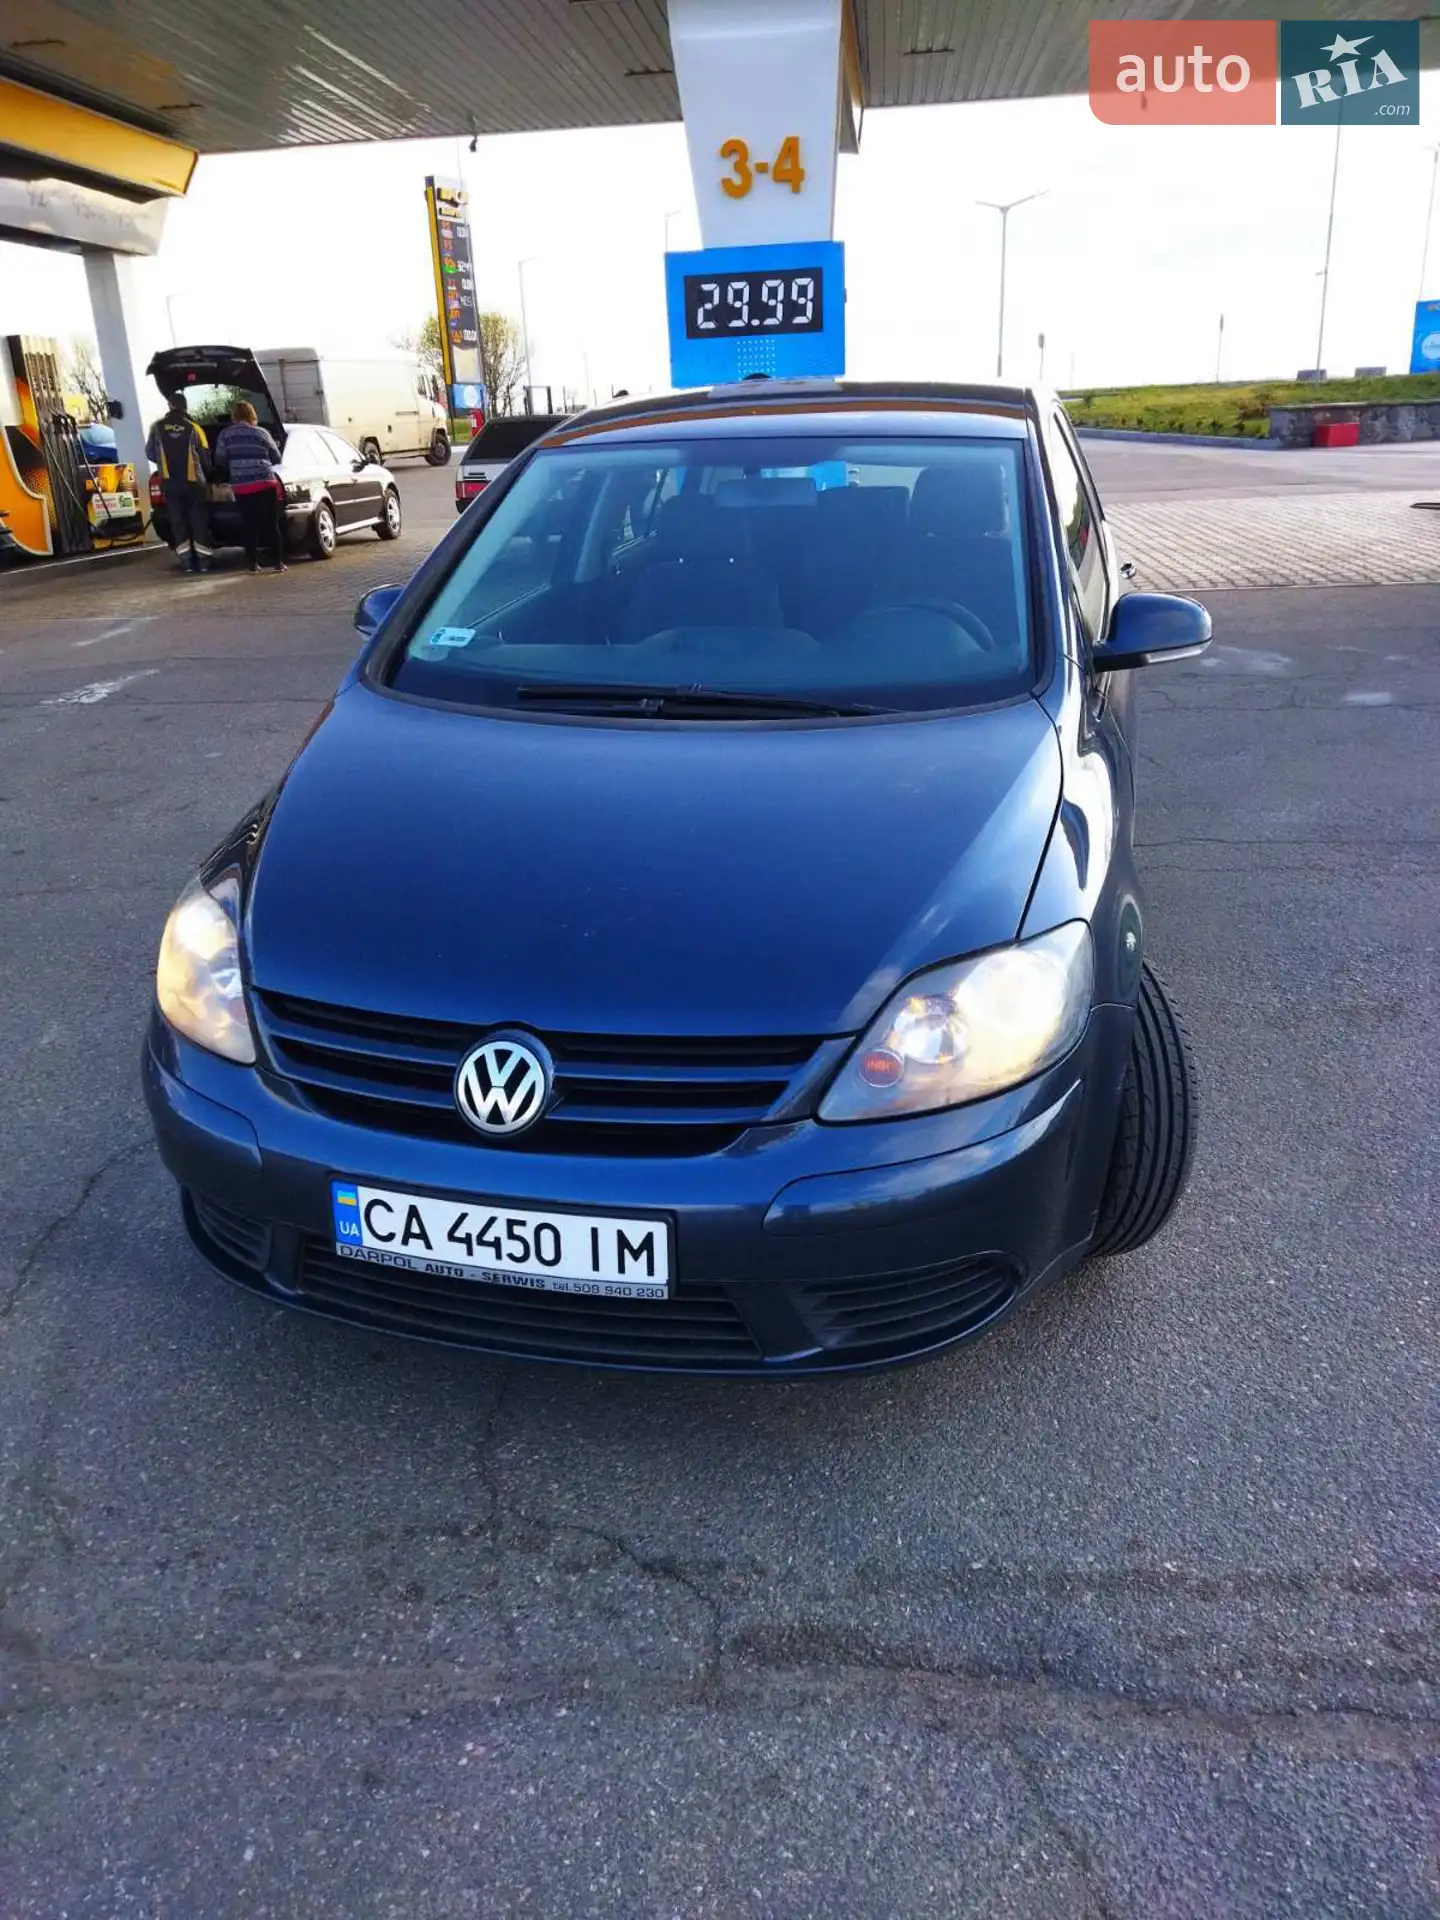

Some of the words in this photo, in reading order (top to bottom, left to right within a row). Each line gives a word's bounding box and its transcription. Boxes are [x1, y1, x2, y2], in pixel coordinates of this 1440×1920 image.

[720, 136, 805, 199] 3-4
[697, 277, 815, 329] 29.99
[339, 1220, 360, 1237] UA
[363, 1198, 433, 1250] CA
[447, 1212, 562, 1267] 4450
[591, 1227, 655, 1277] IM
[340, 1245, 417, 1270] DARPOL
[425, 1263, 464, 1278] AUTO
[482, 1271, 545, 1289] SERWIS
[636, 1287, 665, 1298] 230
